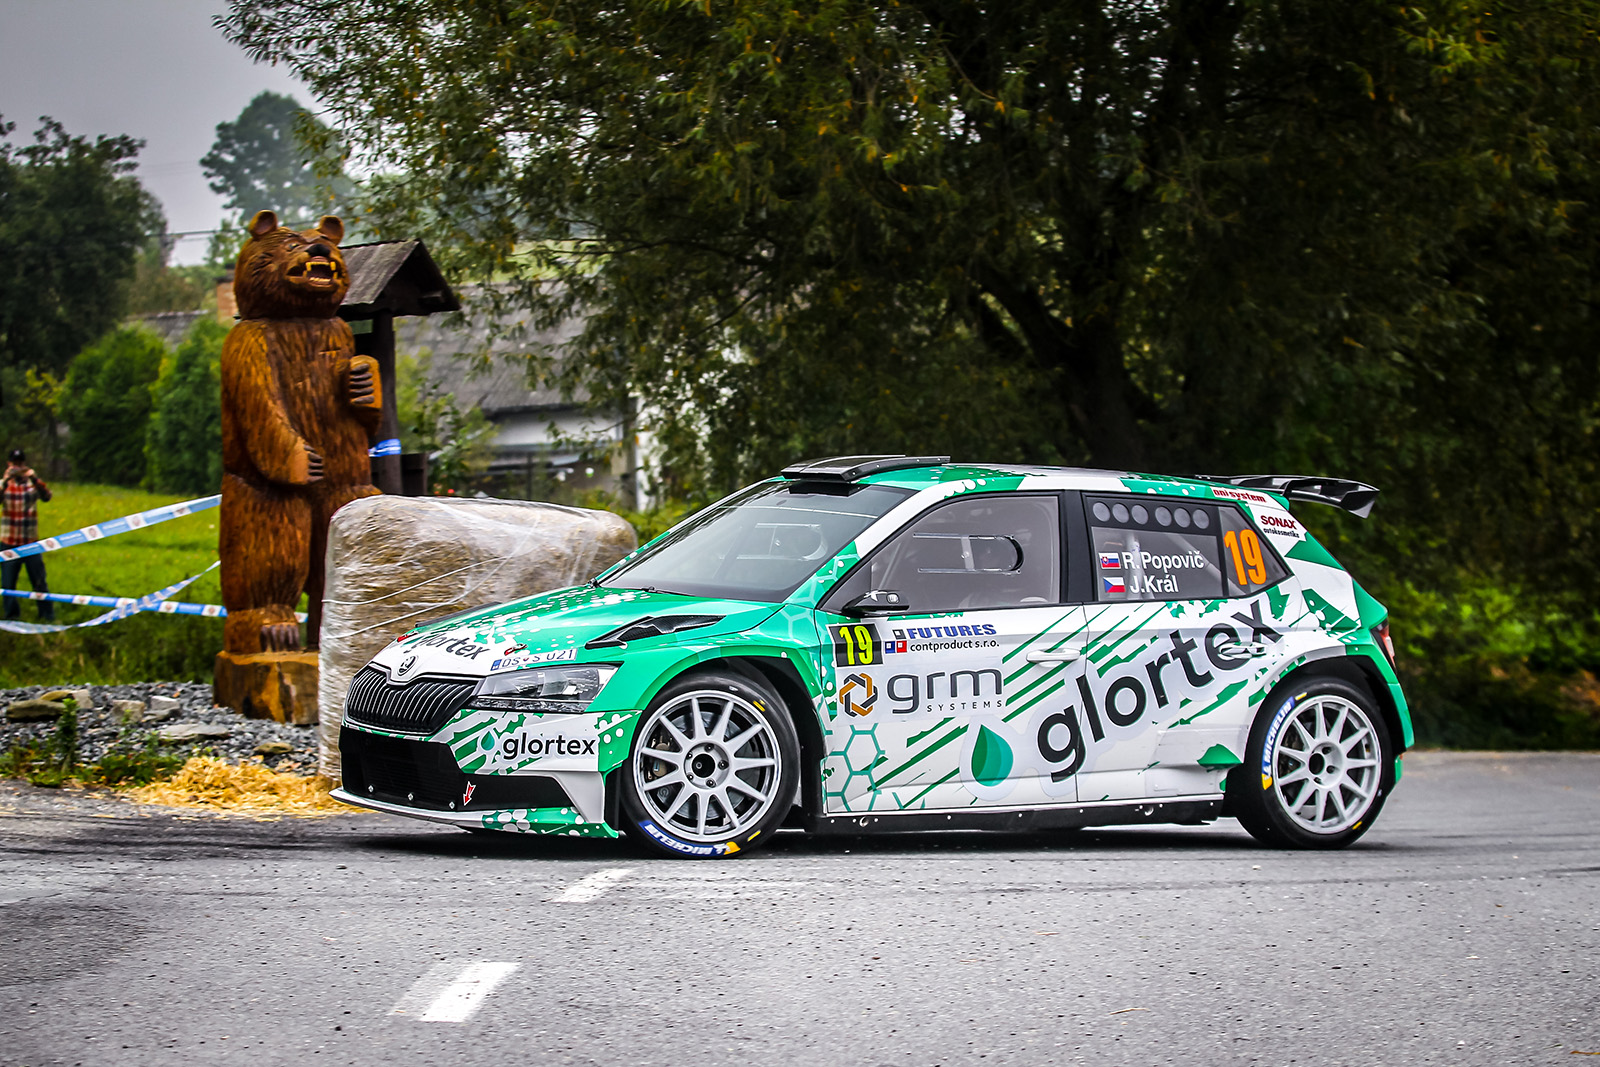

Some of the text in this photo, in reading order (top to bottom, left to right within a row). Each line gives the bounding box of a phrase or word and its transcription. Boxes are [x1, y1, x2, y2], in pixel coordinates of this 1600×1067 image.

[1260, 515, 1297, 530] SONAX
[1263, 527, 1300, 538] autokosmetika
[1140, 550, 1204, 574] Popovič
[1223, 528, 1267, 586] 19
[906, 623, 997, 640] FUTURES
[838, 625, 873, 665] 19
[910, 638, 1000, 653] contproduct s.r.o.
[886, 668, 1002, 714] grm
[1037, 600, 1283, 783] glortex
[926, 699, 1002, 713] SYSTEMS
[1263, 701, 1293, 764] MICHELIN
[502, 732, 596, 760] glortex
